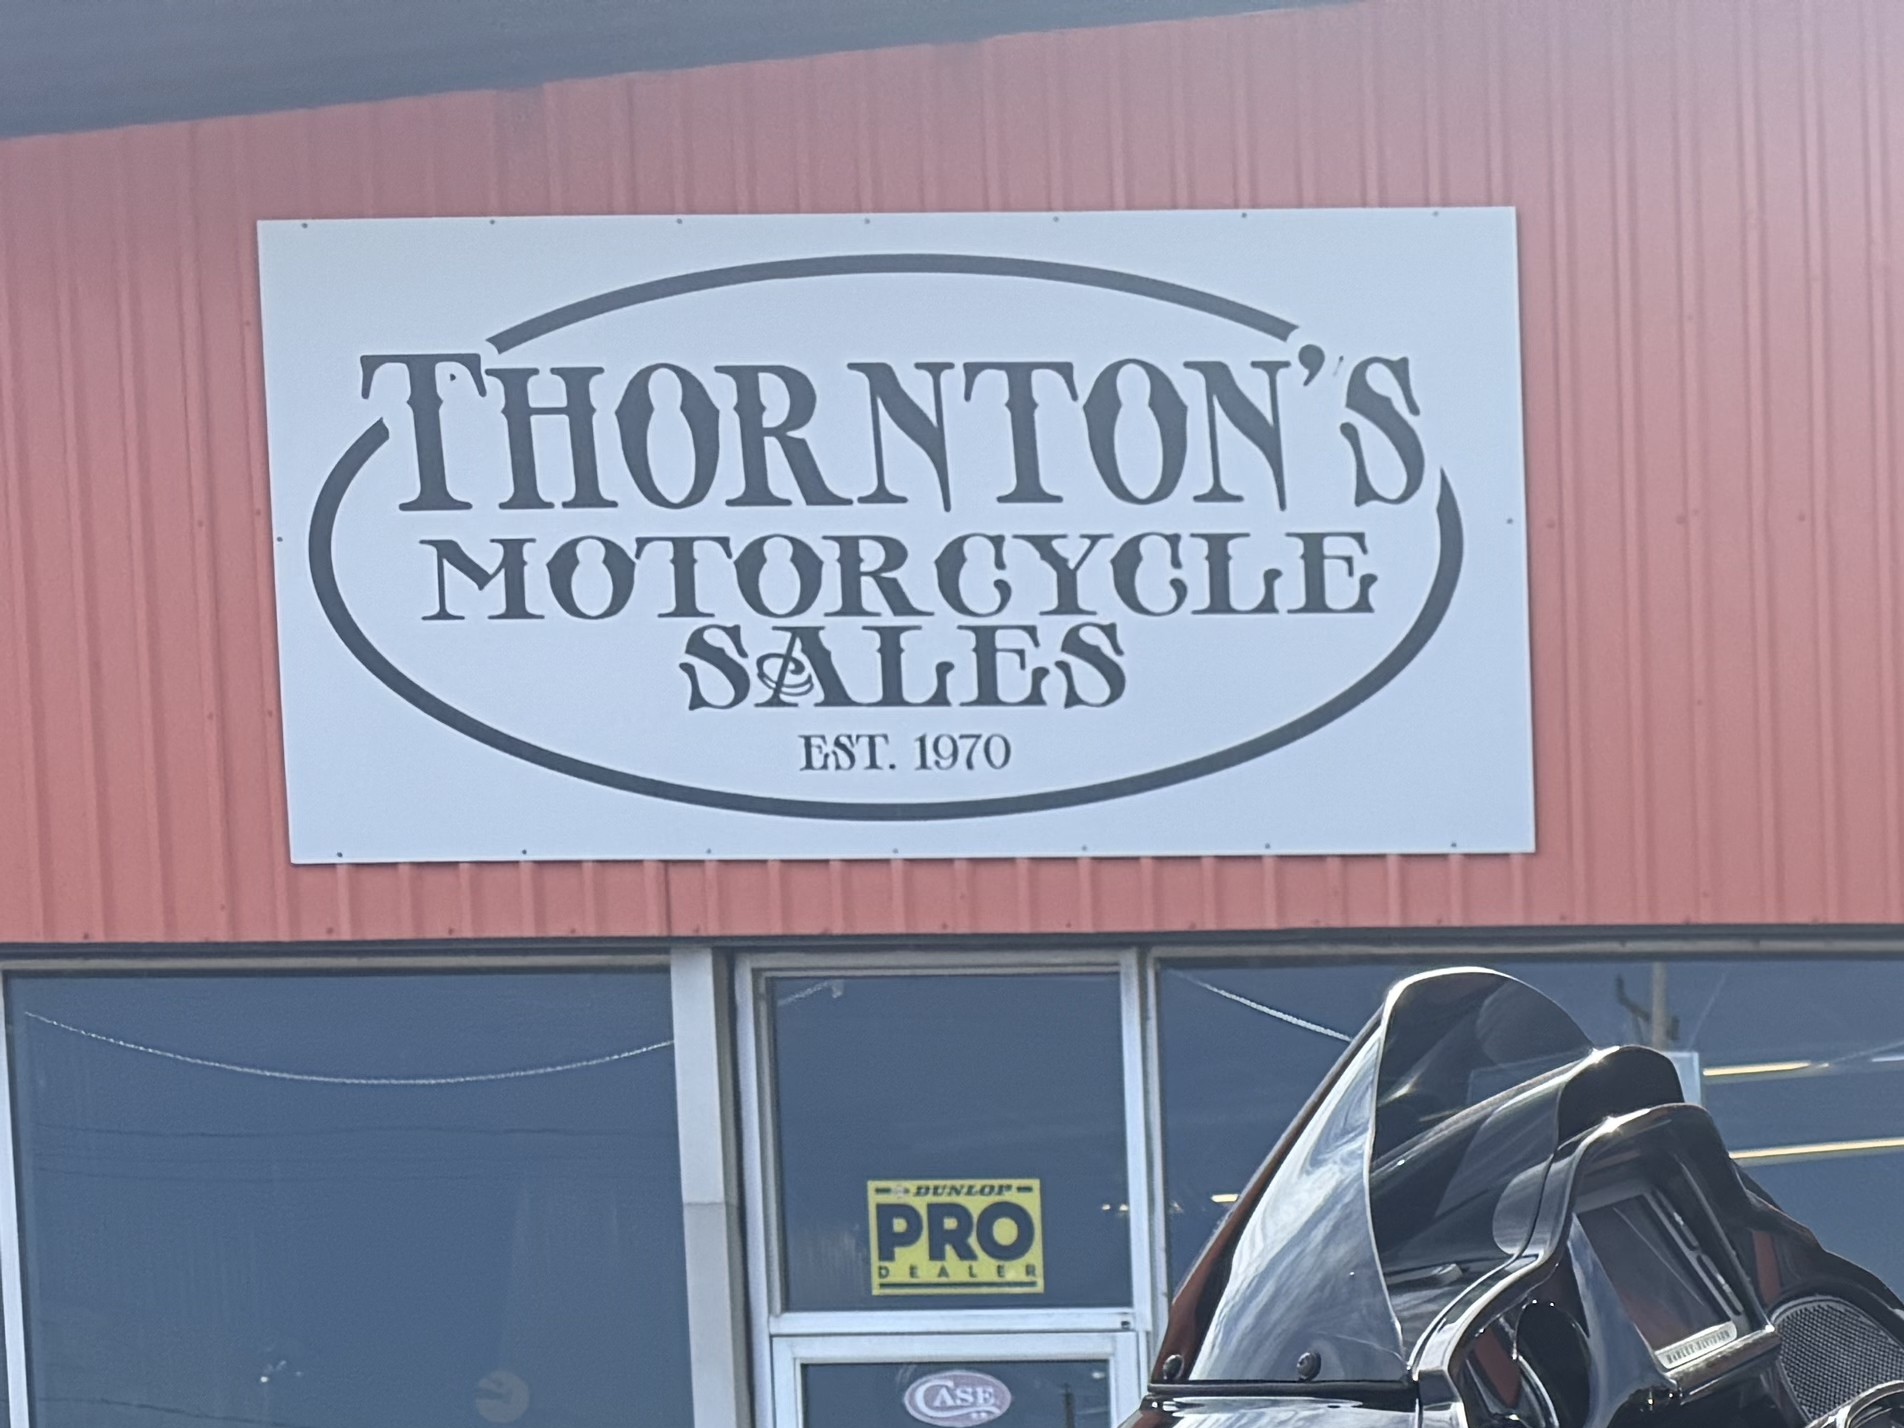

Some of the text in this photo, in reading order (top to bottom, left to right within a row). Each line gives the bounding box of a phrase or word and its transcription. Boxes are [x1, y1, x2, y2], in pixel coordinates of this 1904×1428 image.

[361, 343, 1432, 513] THORNTON'S
[421, 530, 1379, 623] MOTORCYCLE
[680, 620, 1129, 712] SALES
[798, 732, 1012, 773] EST. 1970
[913, 1184, 1012, 1198] DUNLOP
[875, 1201, 1035, 1262] PRO
[878, 1264, 1037, 1280] DEALER
